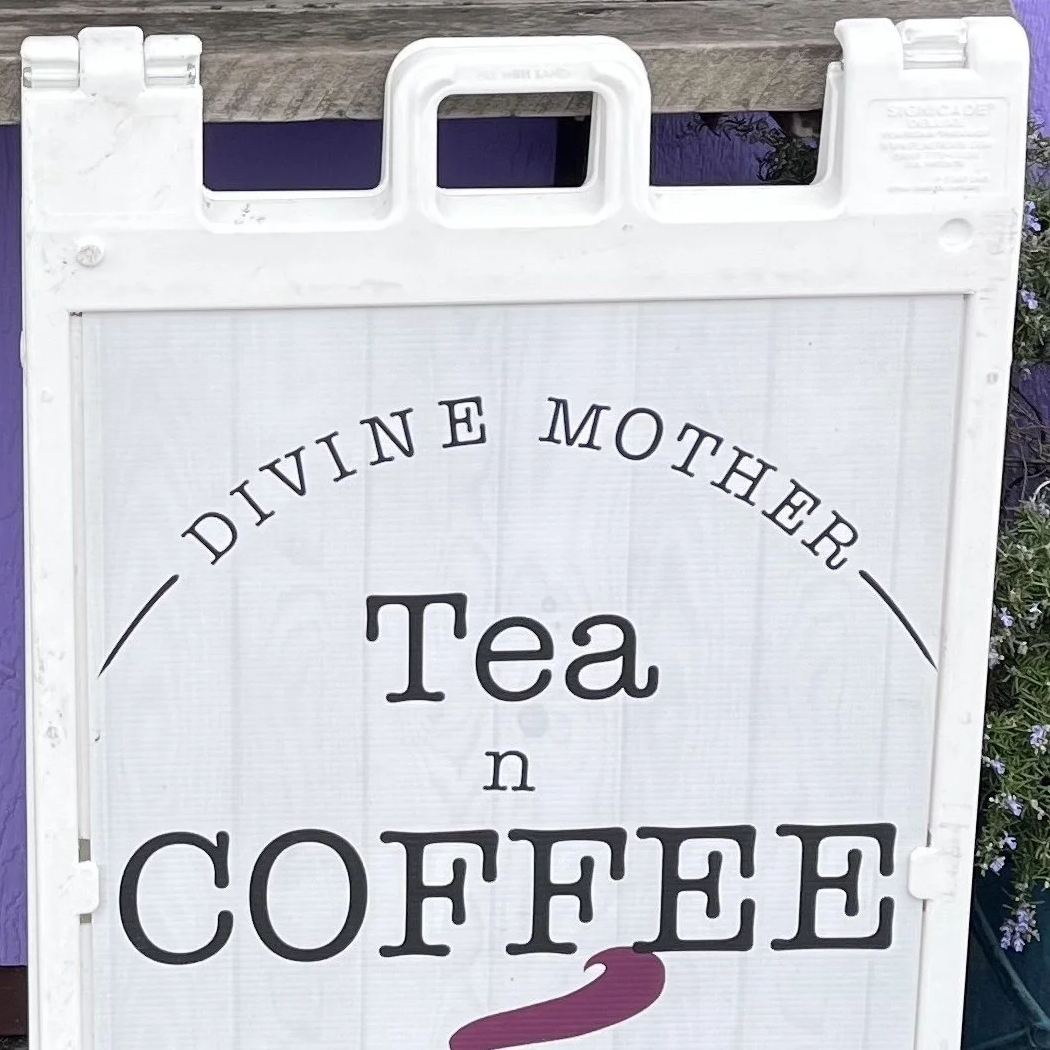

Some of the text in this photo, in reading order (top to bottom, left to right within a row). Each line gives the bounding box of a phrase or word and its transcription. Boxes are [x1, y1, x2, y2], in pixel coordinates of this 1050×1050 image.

[181, 395, 863, 572] DIVINE MOTHER
[365, 592, 660, 705] Tea
[482, 750, 536, 792] n
[118, 822, 897, 965] COFFEE
